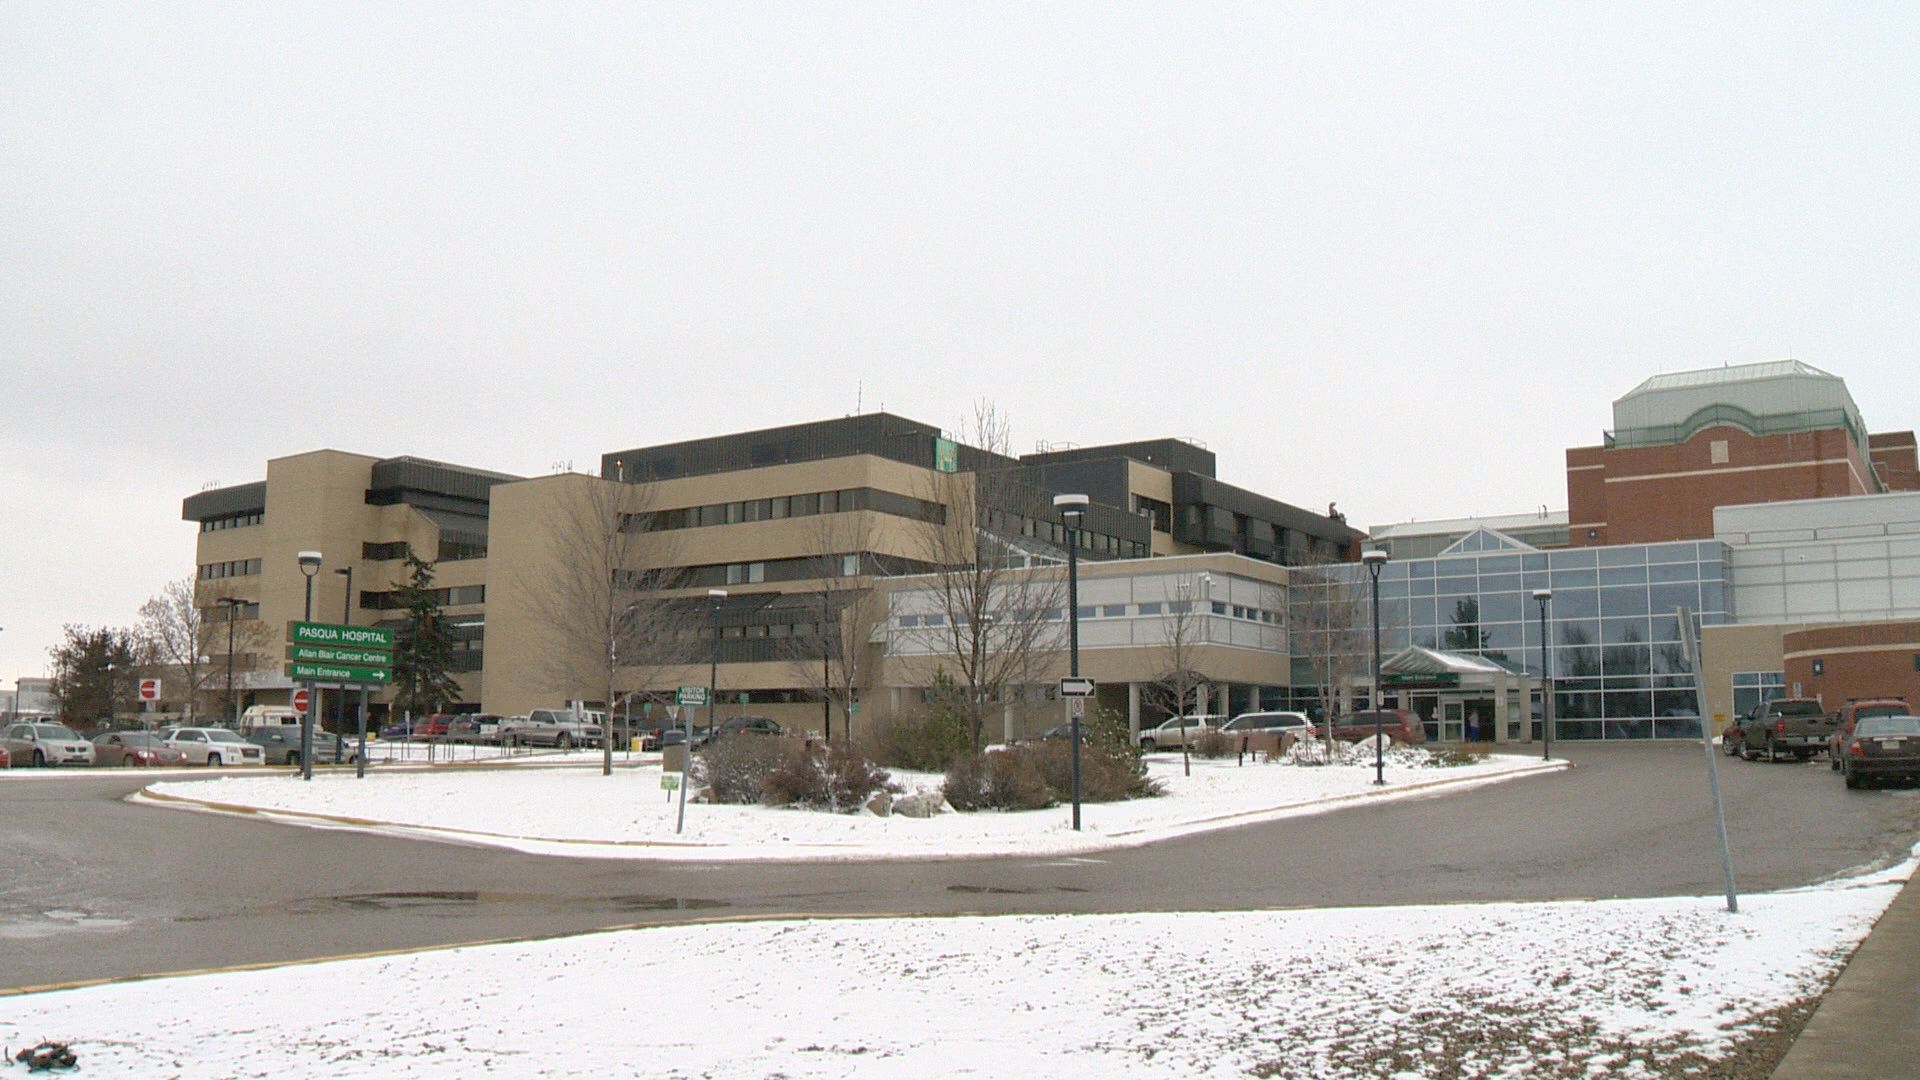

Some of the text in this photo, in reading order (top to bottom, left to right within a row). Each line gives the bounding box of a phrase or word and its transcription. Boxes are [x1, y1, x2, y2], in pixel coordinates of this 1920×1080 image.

[299, 627, 387, 643] PASQUA HOSPITAL
[298, 648, 387, 663] Allan Blair Cancer Centre
[296, 666, 351, 678] Main Entrance
[679, 693, 706, 701] PARKING
